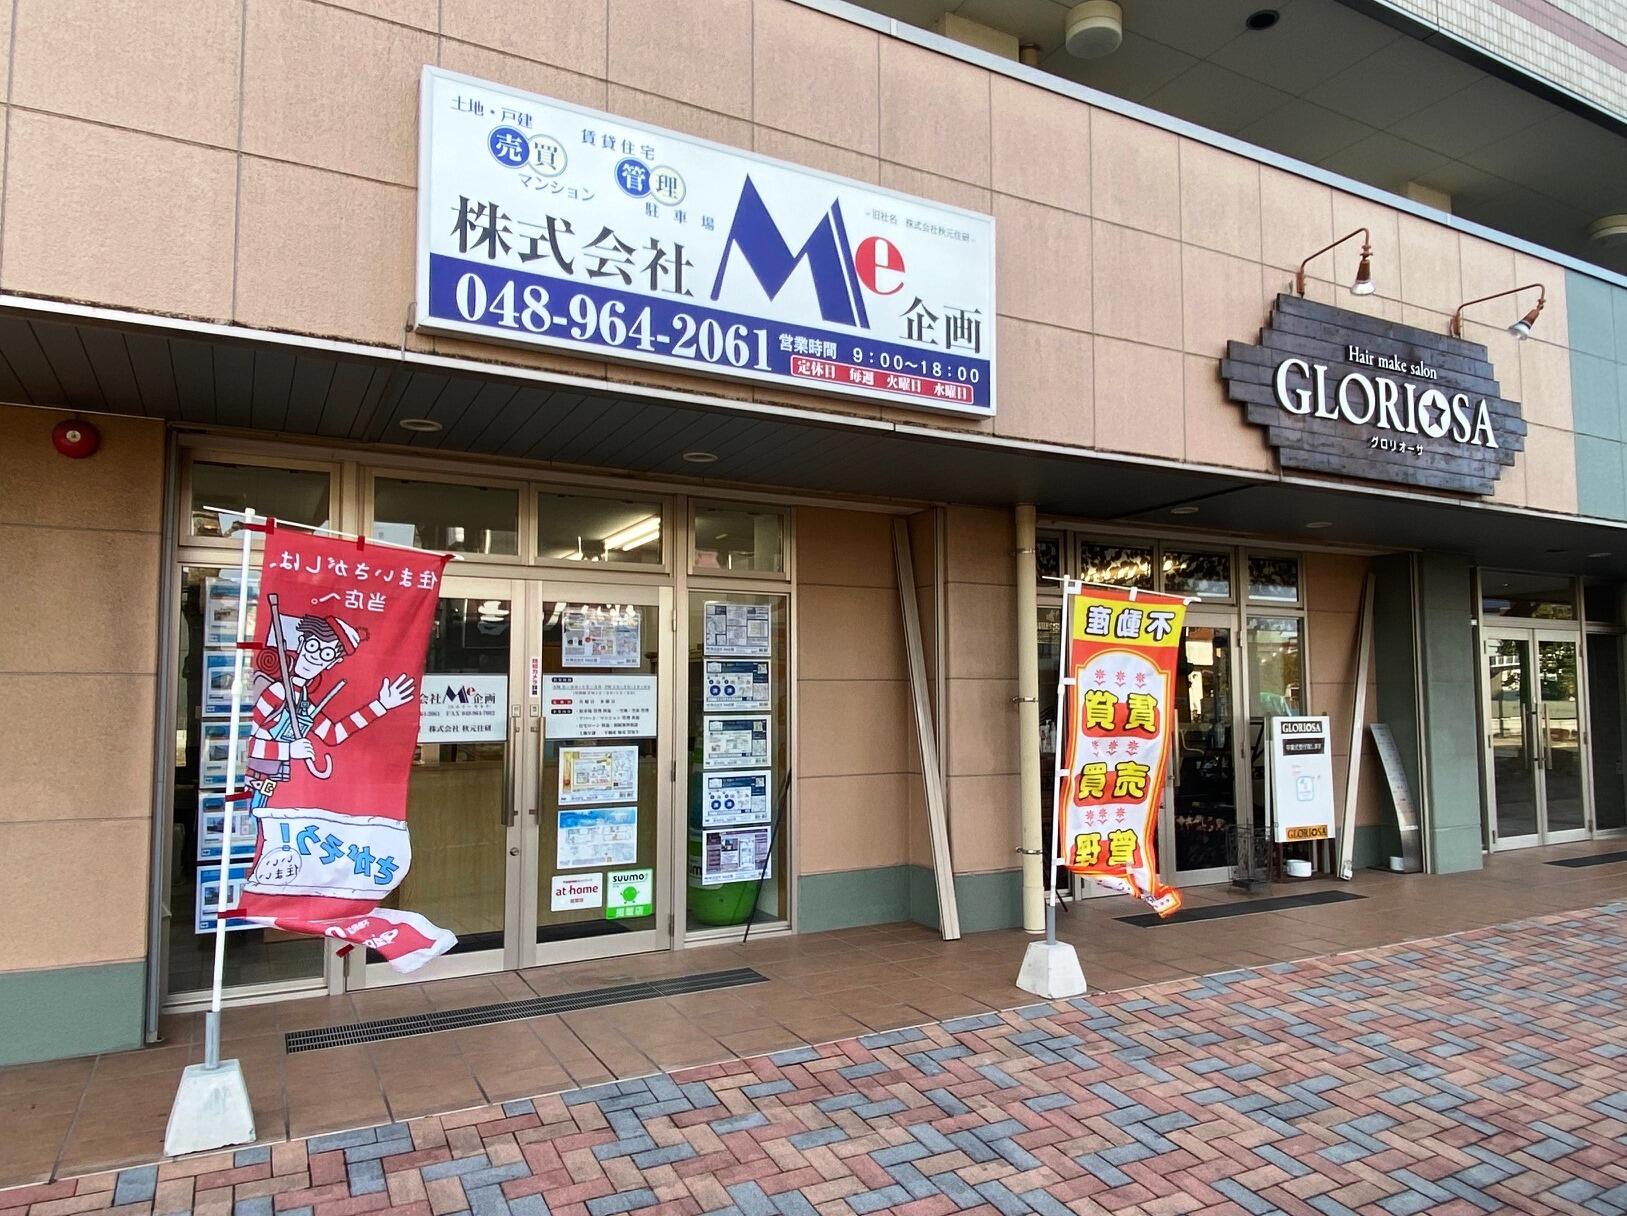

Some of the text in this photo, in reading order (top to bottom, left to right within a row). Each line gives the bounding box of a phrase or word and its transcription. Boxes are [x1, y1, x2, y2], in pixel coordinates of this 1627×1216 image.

[451, 95, 533, 129] 土地・戸建
[496, 133, 558, 171] 売買
[580, 128, 655, 161] 賃貸住宅
[517, 172, 596, 202] マンション
[621, 163, 678, 200] 管理
[645, 202, 715, 232] 駐車場
[450, 194, 695, 298] 株式会社
[899, 295, 984, 355] 企画
[456, 272, 773, 373] 048-964-2061
[778, 332, 838, 361] 営業時間
[1348, 345, 1438, 380] Hair make salon
[797, 358, 968, 401] 定休日 毎週 火曜日 水曜日
[1276, 358, 1499, 449] GLORIOSA
[1370, 436, 1424, 456] グロリオーサ
[1282, 723, 1321, 733] GLORIOSA
[1287, 827, 1328, 840] GLORIOSA
[555, 885, 599, 896] at home
[612, 873, 645, 883] suumo
